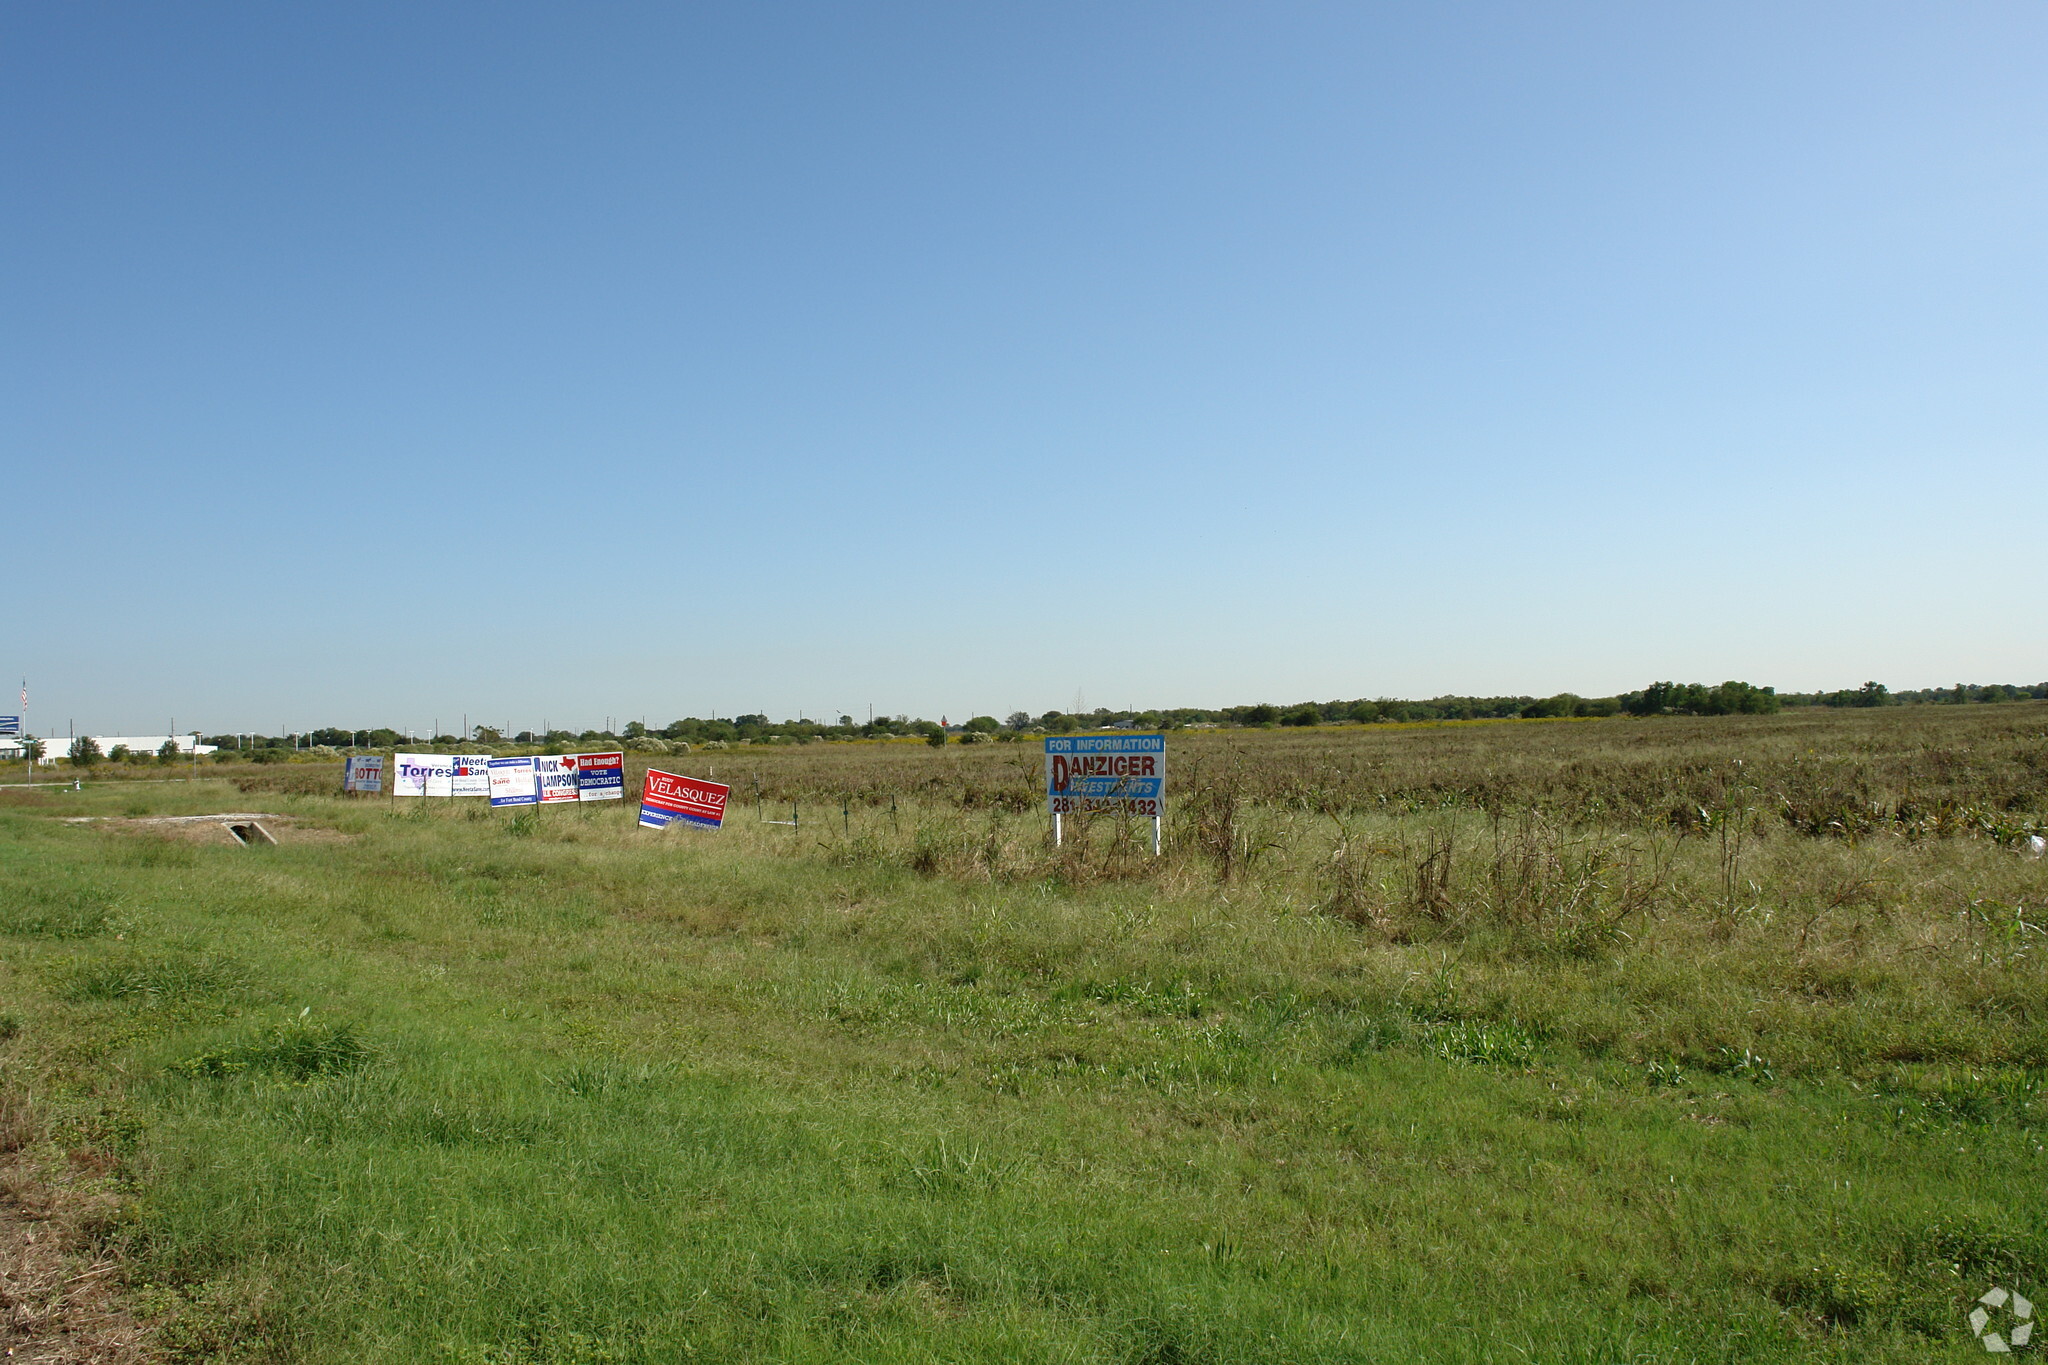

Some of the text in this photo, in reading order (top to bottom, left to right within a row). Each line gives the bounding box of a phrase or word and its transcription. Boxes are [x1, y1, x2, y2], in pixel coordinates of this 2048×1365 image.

[1049, 738, 1161, 751] FOR INFORMATION
[541, 760, 559, 773] NICK
[580, 756, 620, 767] Had Enough?
[400, 764, 452, 777] Torres
[1053, 755, 1155, 792] DANZIGER
[542, 773, 577, 788] LAMPSON
[580, 776, 621, 787] DEMOCRATIC
[1070, 780, 1153, 793] INVESTNTS
[649, 776, 726, 806] VELASQUEZ
[645, 797, 666, 805] DEMOCRAT
[673, 803, 689, 811] COUNTY
[641, 809, 674, 821] EXPERIENCE
